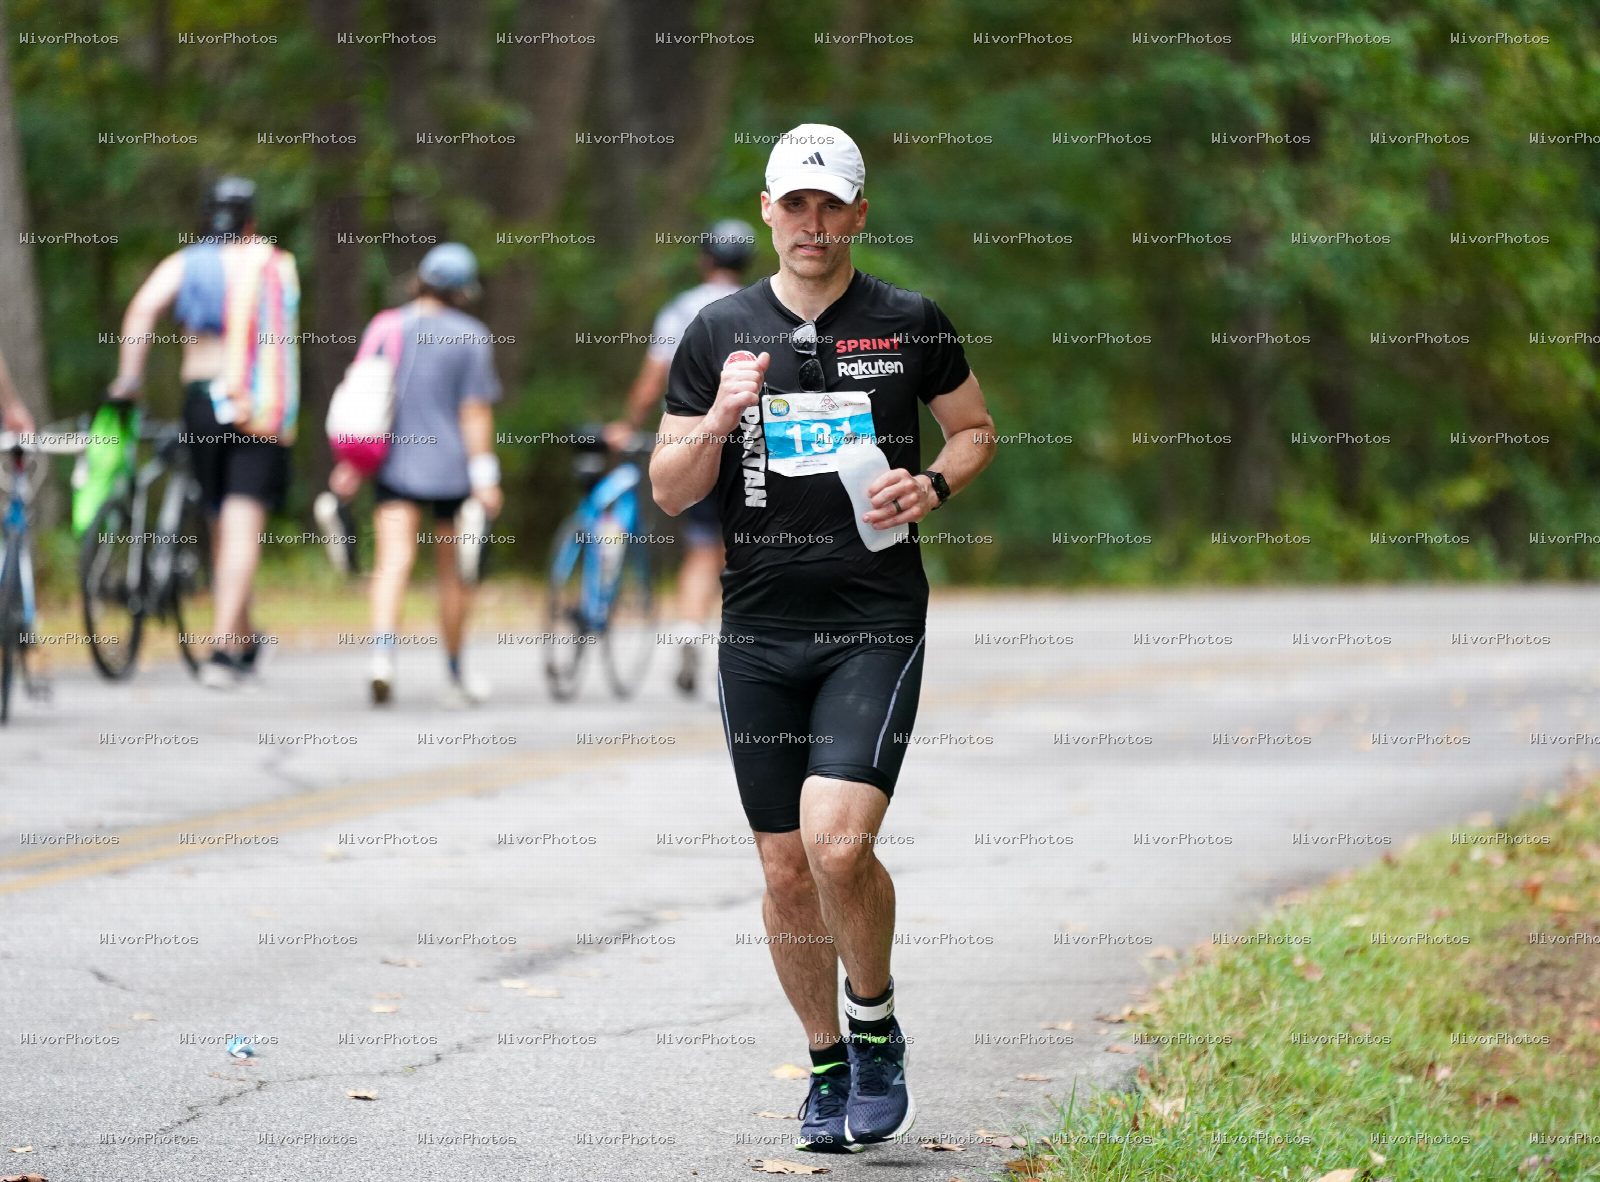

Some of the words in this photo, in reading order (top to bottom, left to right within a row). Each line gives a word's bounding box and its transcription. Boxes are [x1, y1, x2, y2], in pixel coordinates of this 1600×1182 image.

[835, 338, 900, 354] SPRINT
[837, 359, 904, 378] Rakuten
[740, 405, 768, 508] PARTAN
